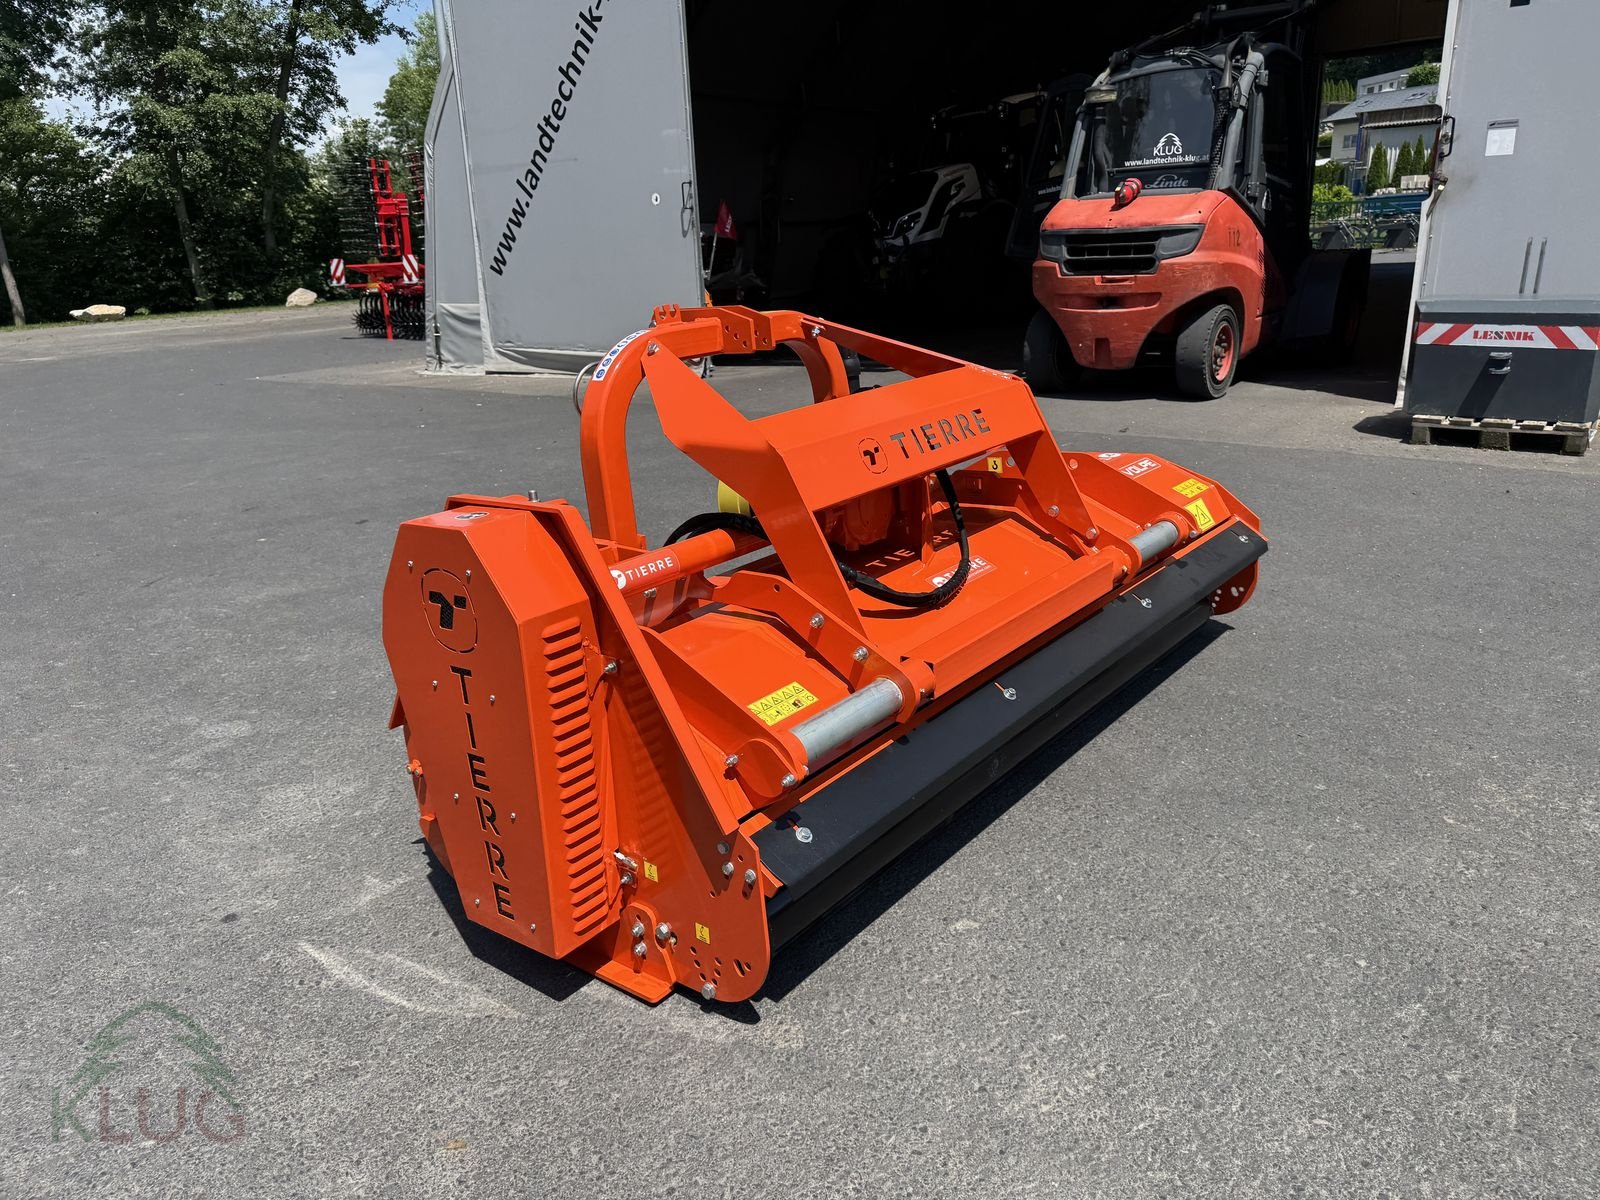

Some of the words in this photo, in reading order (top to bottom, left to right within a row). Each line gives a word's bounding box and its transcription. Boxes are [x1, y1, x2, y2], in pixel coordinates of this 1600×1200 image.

[489, 0, 610, 277] www.landtechnik-
[1153, 145, 1183, 156] KLUG
[1124, 154, 1210, 167] www.landtechnik-klug.at
[1144, 173, 1189, 188] Linde
[1473, 330, 1535, 341] LESNIK
[889, 408, 991, 459] TIERRE
[1120, 459, 1157, 476] VOLPE
[624, 556, 674, 581] TIERRE
[449, 664, 516, 922] TIERRE
